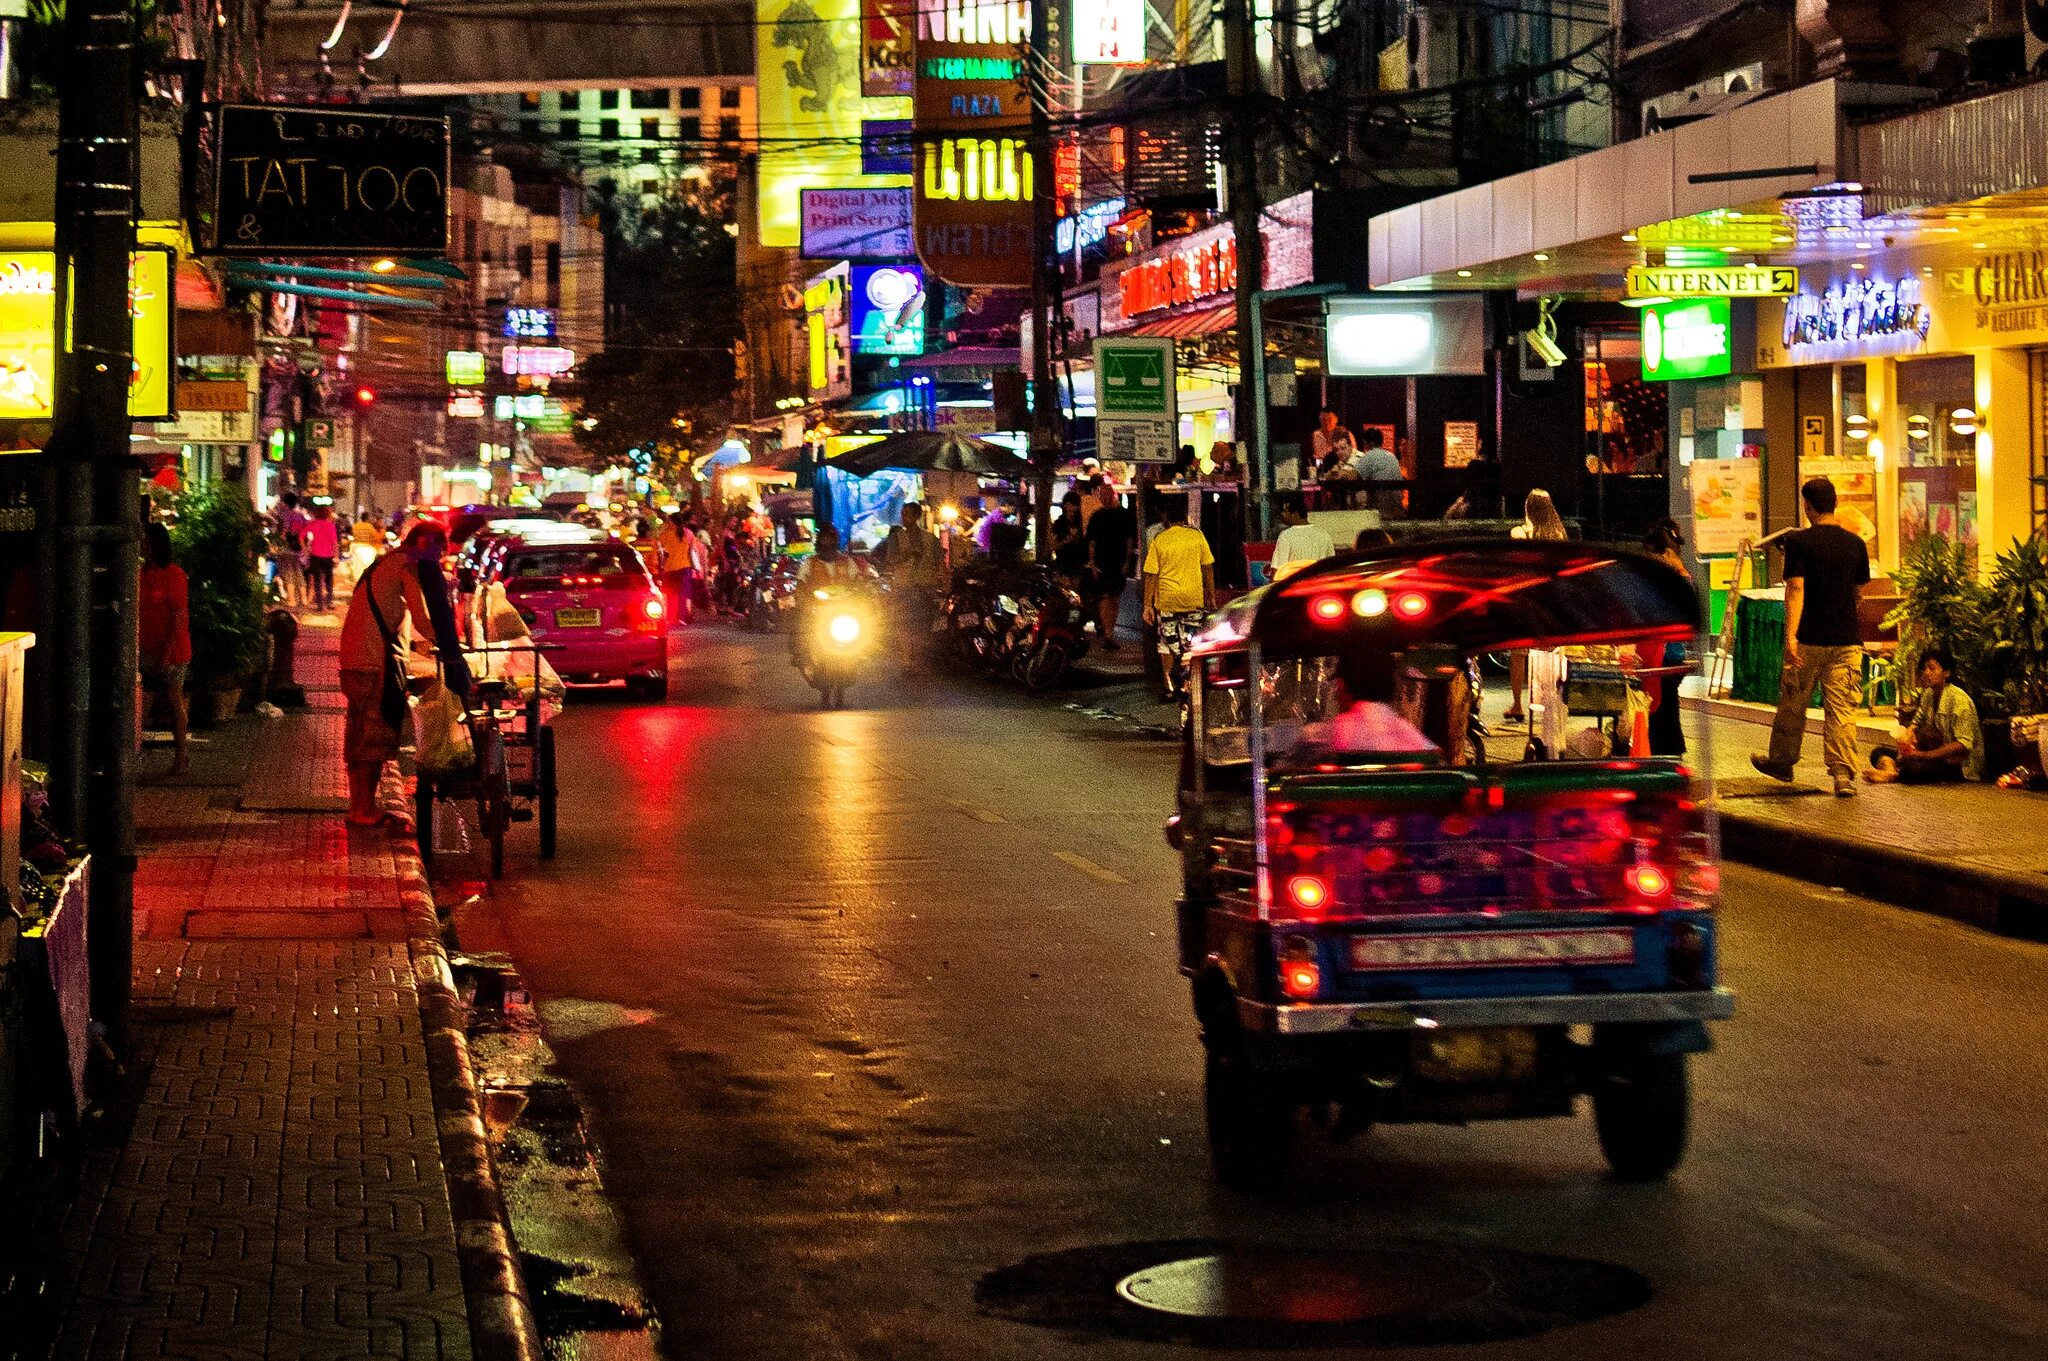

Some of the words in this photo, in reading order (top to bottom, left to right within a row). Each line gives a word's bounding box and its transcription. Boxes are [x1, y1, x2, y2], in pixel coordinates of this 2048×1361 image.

[951, 95, 1001, 116] PLAZA
[809, 193, 866, 208] Digital
[1634, 273, 1767, 292] INTERNET
